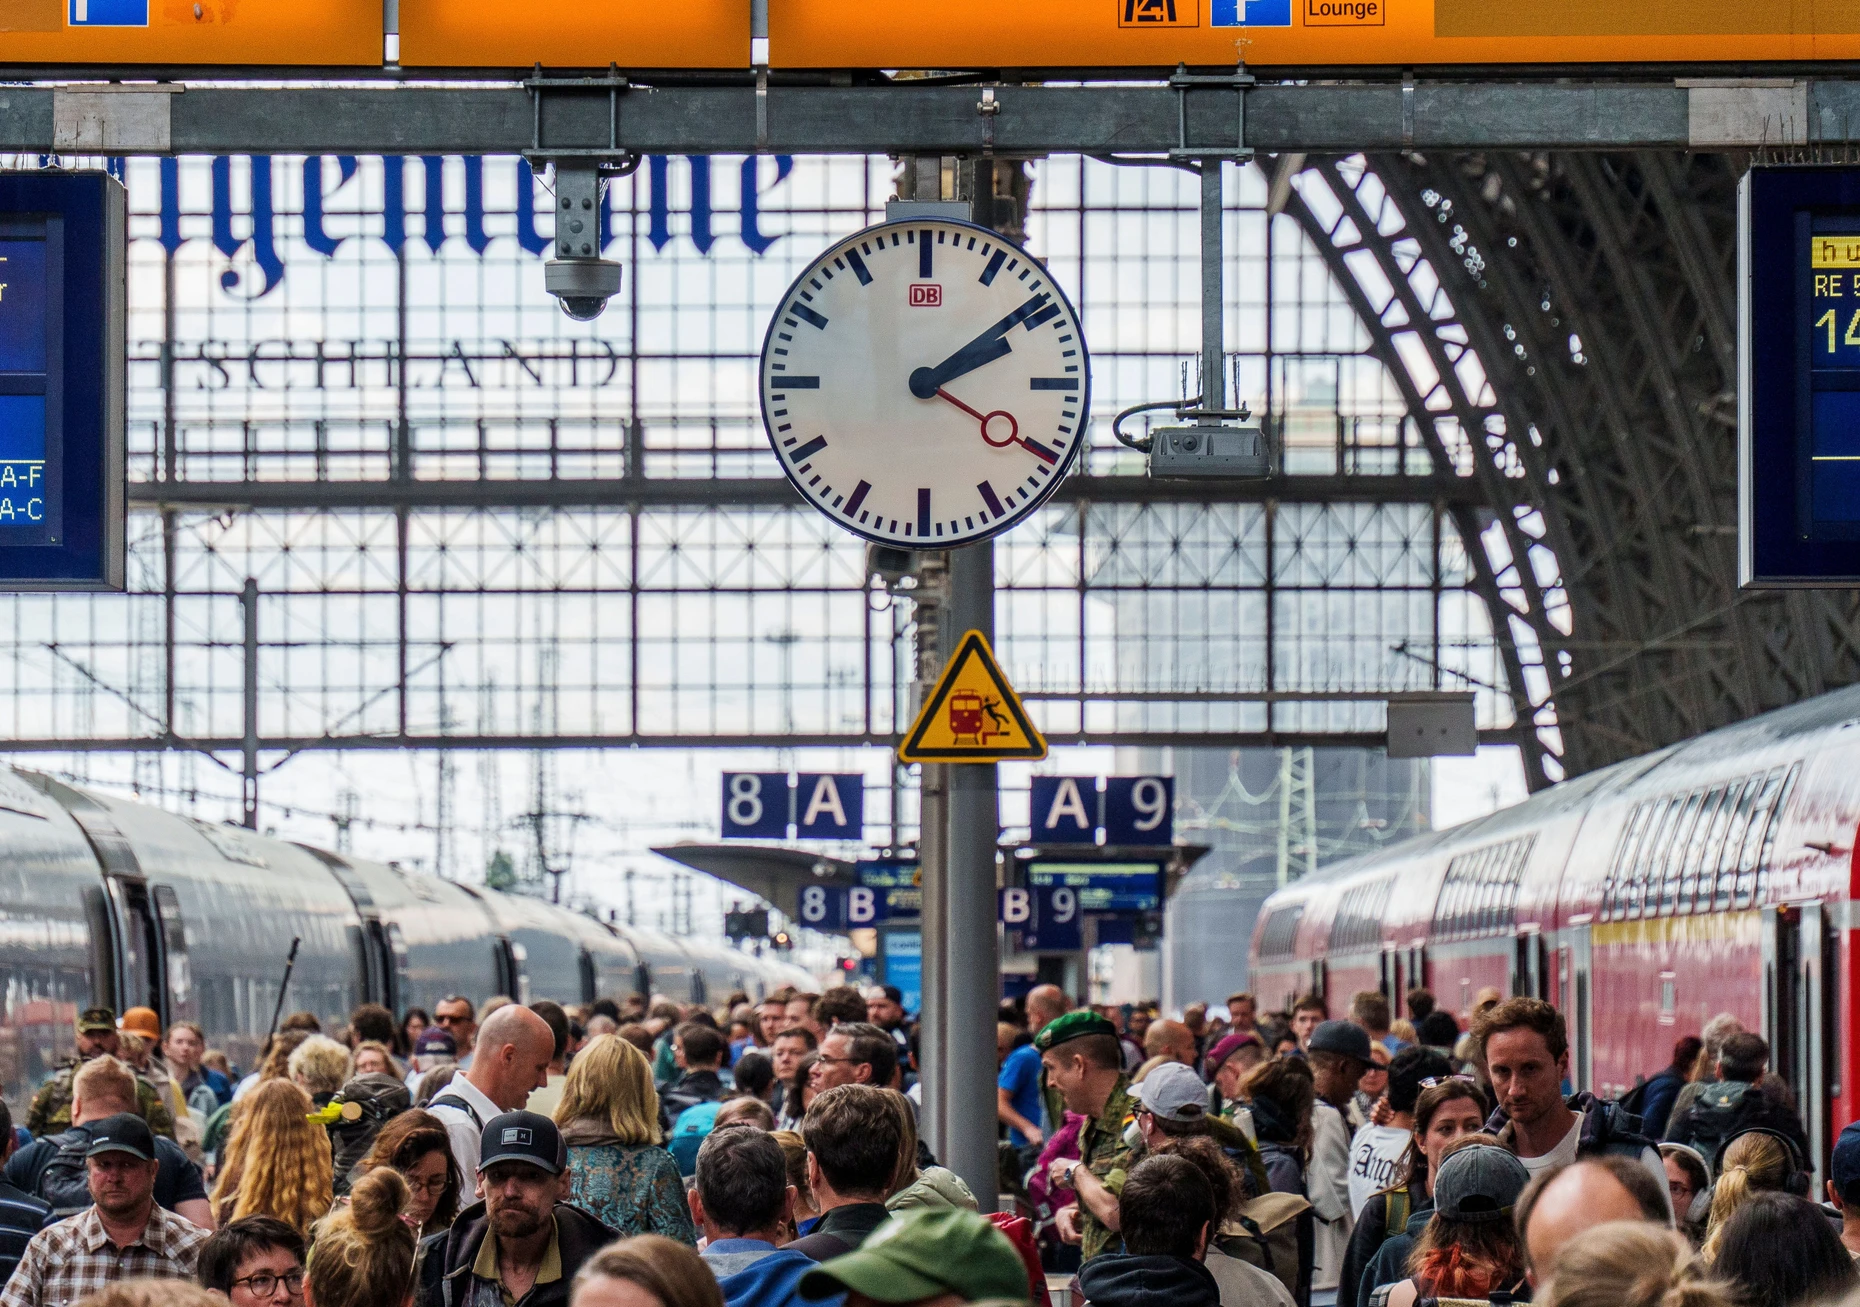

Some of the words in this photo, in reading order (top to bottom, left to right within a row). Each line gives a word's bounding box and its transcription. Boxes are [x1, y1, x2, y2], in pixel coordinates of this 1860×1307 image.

[1309, 0, 1377, 20] Lounge
[913, 287, 938, 304] DB
[1815, 274, 1843, 297] RE
[1, 465, 43, 488] A-F
[0, 497, 43, 520] A-C
[727, 773, 763, 826] 8
[803, 774, 847, 827] A
[1045, 777, 1090, 829] A
[1131, 778, 1167, 832] 9
[802, 885, 827, 922] 8
[848, 886, 876, 923] B
[1003, 886, 1030, 924] B
[1052, 887, 1077, 924] 9
